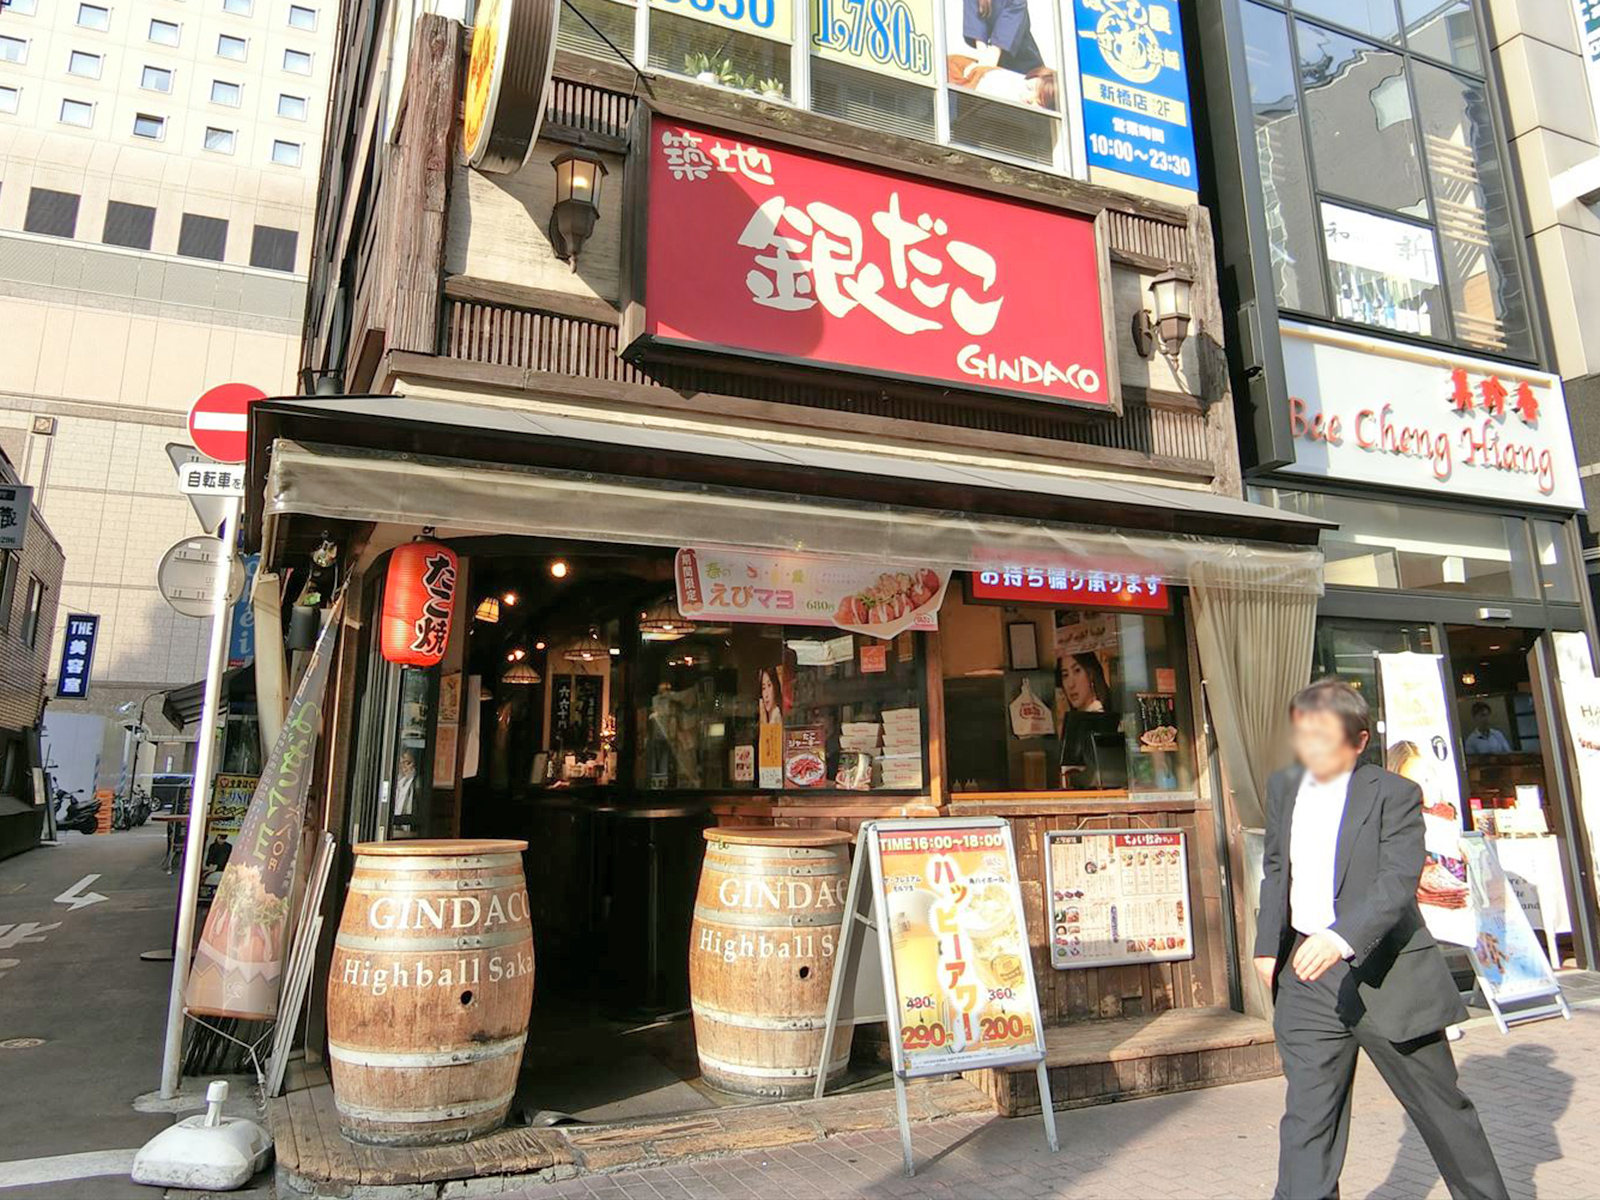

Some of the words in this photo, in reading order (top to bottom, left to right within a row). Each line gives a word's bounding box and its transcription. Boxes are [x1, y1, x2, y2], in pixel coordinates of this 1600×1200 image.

[1099, 83, 1147, 111] 新橋店
[661, 131, 775, 185] 築地
[737, 192, 1004, 336] 銀だこ
[956, 343, 1100, 393] GINDACO
[1289, 396, 1342, 443] Bee
[1355, 403, 1450, 479] Cheng
[1460, 418, 1555, 493] Hiang
[188, 470, 245, 490] 自転車を
[709, 582, 795, 610] えびマヨ
[71, 621, 93, 636] THE
[699, 928, 815, 963] Highball
[343, 957, 479, 996] Highball
